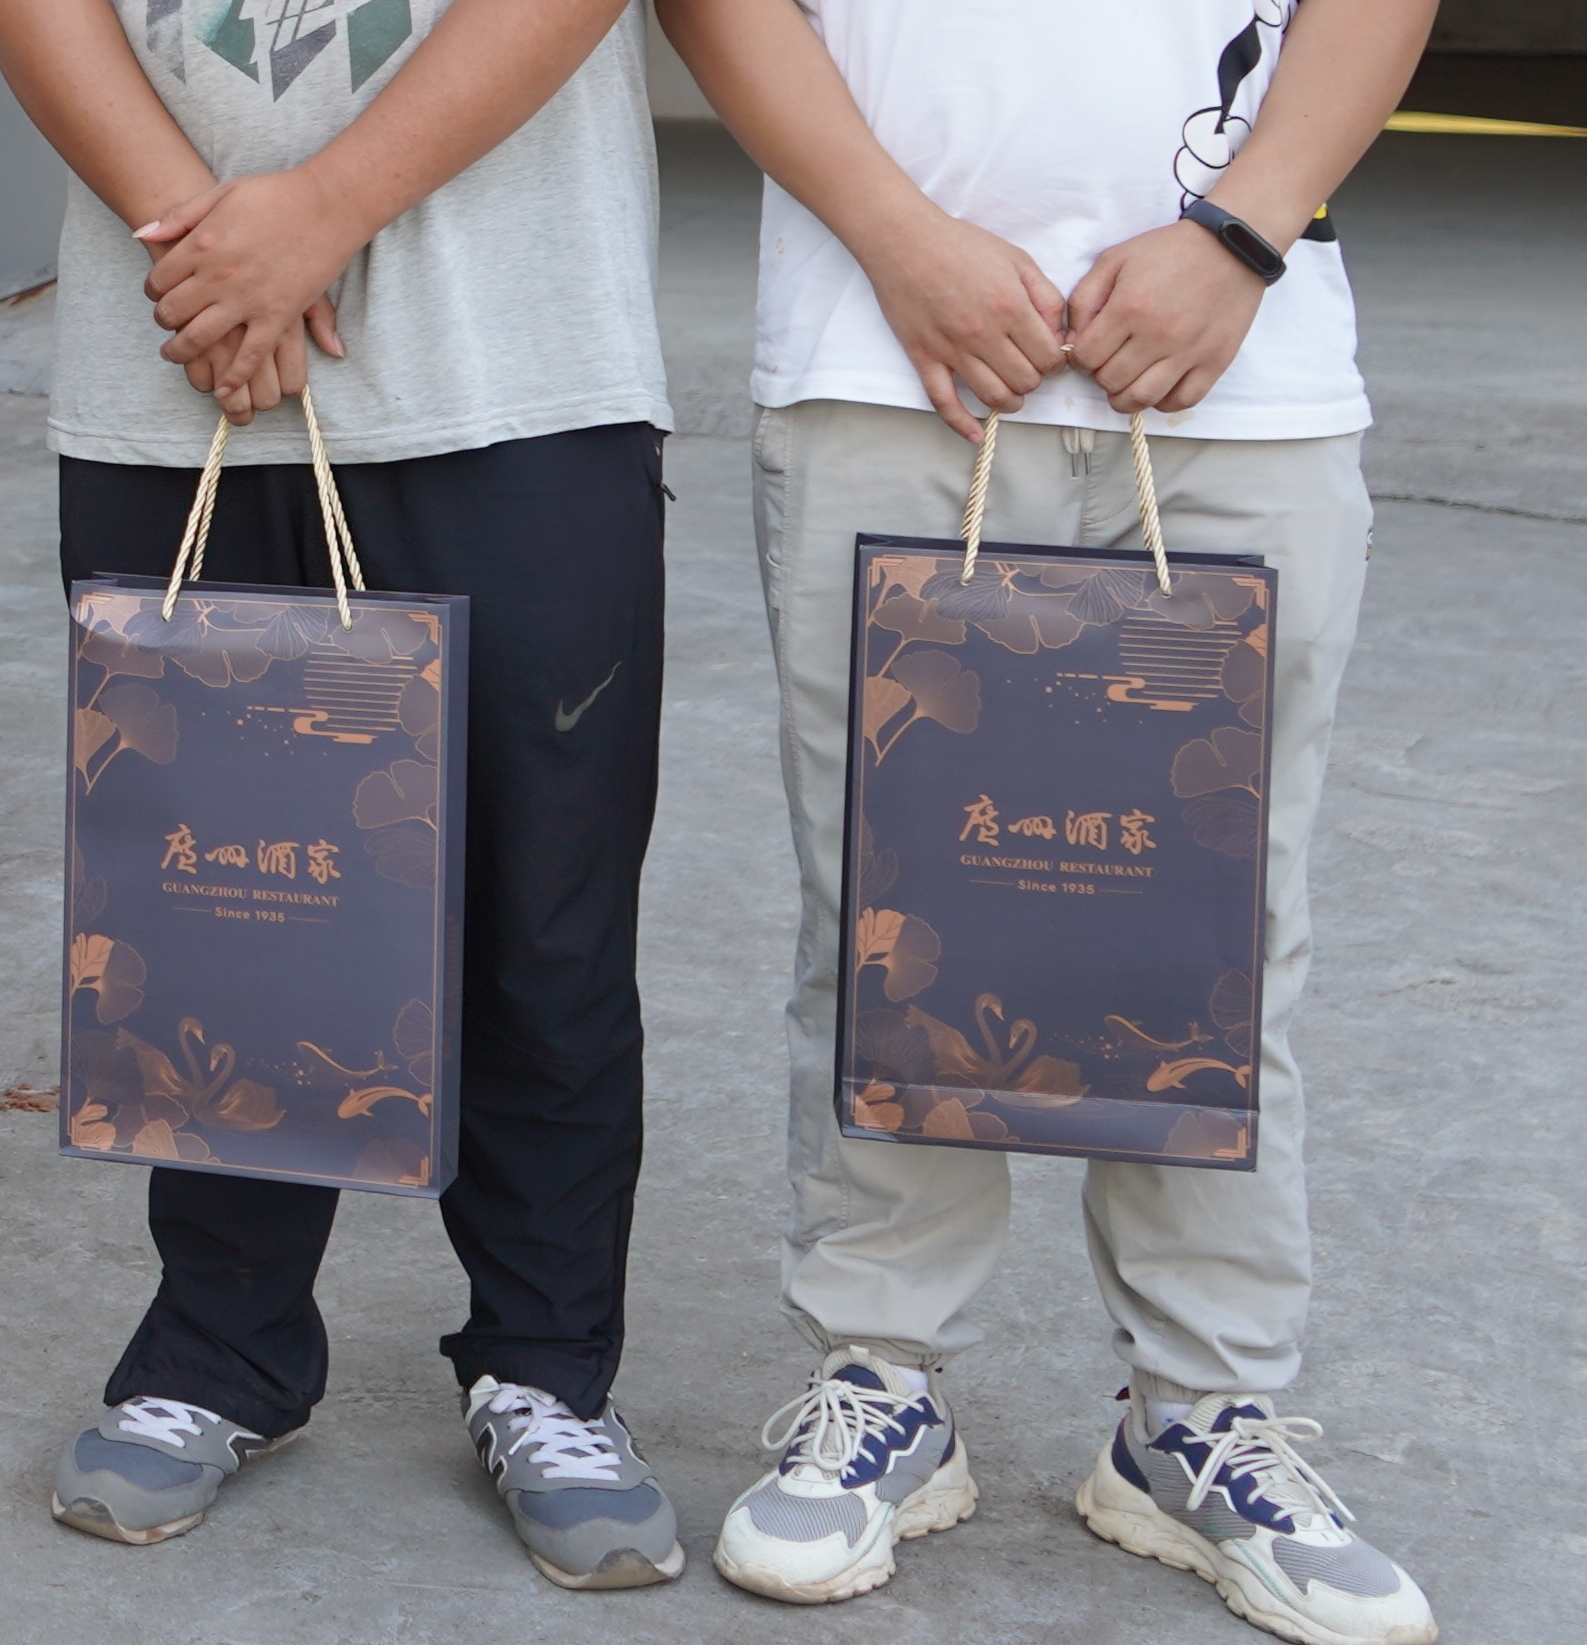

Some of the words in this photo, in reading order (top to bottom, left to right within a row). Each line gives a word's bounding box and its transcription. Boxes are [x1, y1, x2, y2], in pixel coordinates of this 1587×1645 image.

[960, 855, 1054, 872] GUANGZHOU
[1059, 860, 1154, 877] RESTAURANT
[162, 882, 248, 900] GUANGZHOU
[253, 889, 340, 907] RESTAURANT
[1017, 878, 1058, 894] Since
[1062, 882, 1096, 896] 1935
[214, 906, 251, 920] Since
[255, 910, 286, 923] 1935
